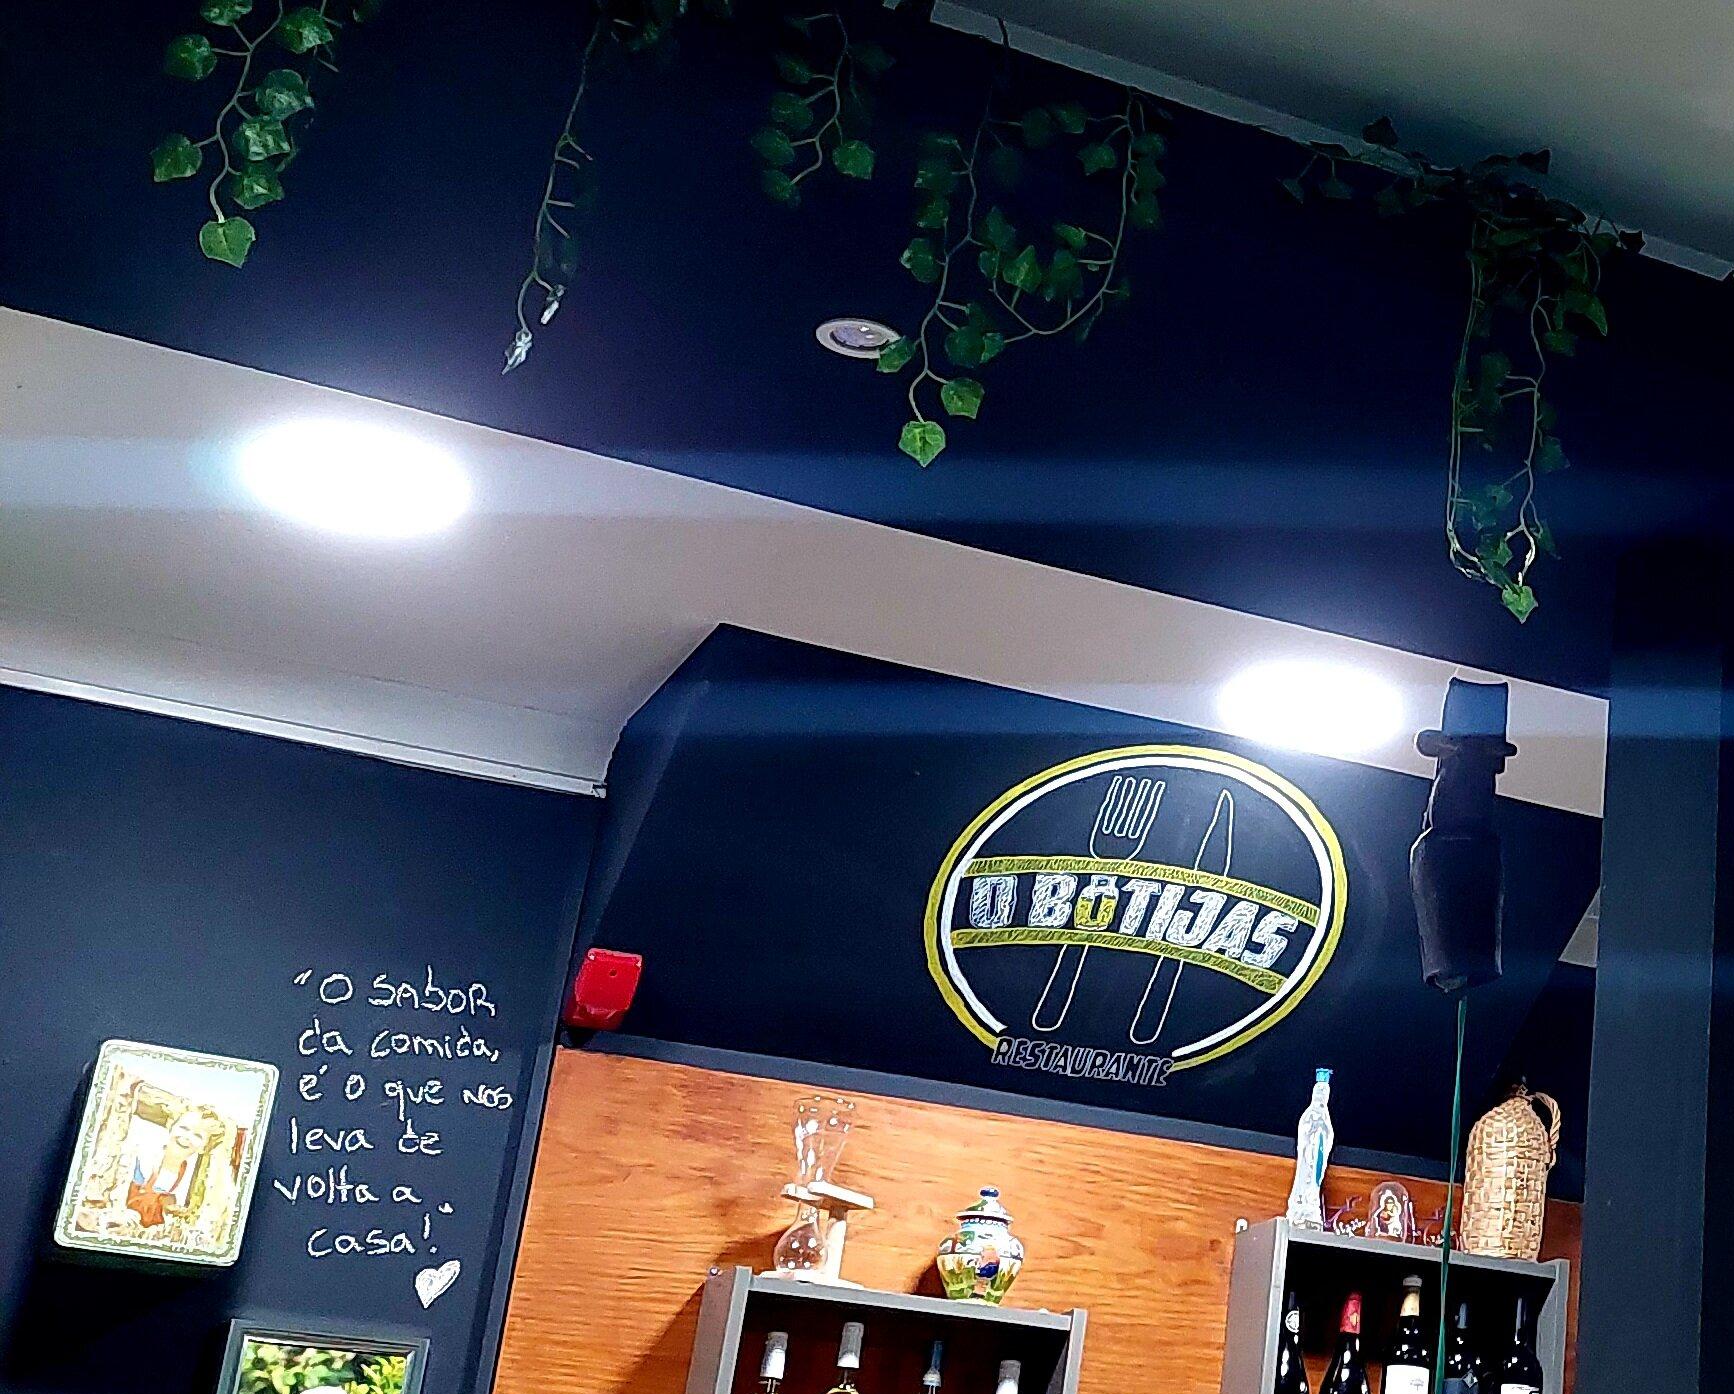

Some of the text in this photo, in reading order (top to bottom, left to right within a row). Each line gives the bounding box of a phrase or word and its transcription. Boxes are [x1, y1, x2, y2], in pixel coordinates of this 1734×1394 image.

[970, 873, 1298, 968] O BOTIJAS
[300, 1019, 353, 1056] da
[992, 1037, 1174, 1088] RESTAURANTE
[384, 1079, 445, 1121] que
[290, 1117, 374, 1154] leva
[274, 1165, 422, 1206] volta a
